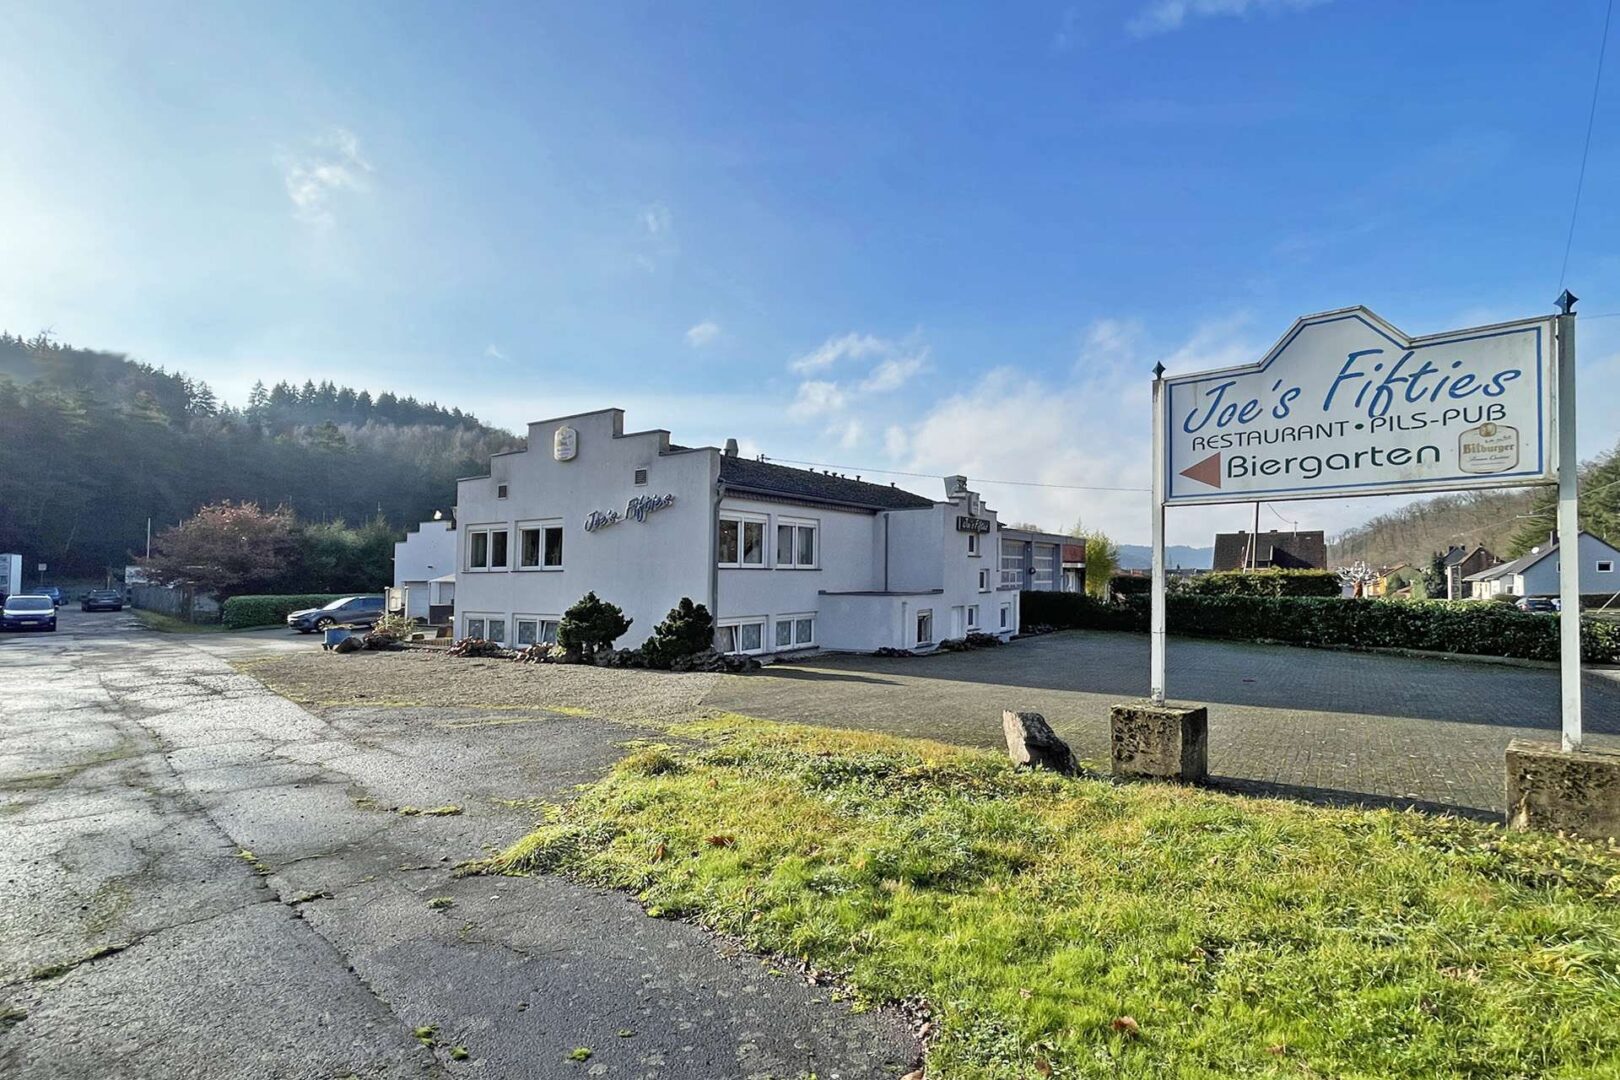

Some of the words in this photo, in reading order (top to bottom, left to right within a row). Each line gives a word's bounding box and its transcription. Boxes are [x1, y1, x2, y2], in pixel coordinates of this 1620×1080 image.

[1183, 378, 1301, 434] Joe's
[1323, 348, 1521, 419] Fifties
[1192, 421, 1349, 451] RESTAURANT
[1370, 403, 1506, 434] PILS-PUB
[1227, 445, 1440, 479] Biergarten
[584, 509, 620, 532] Joe's
